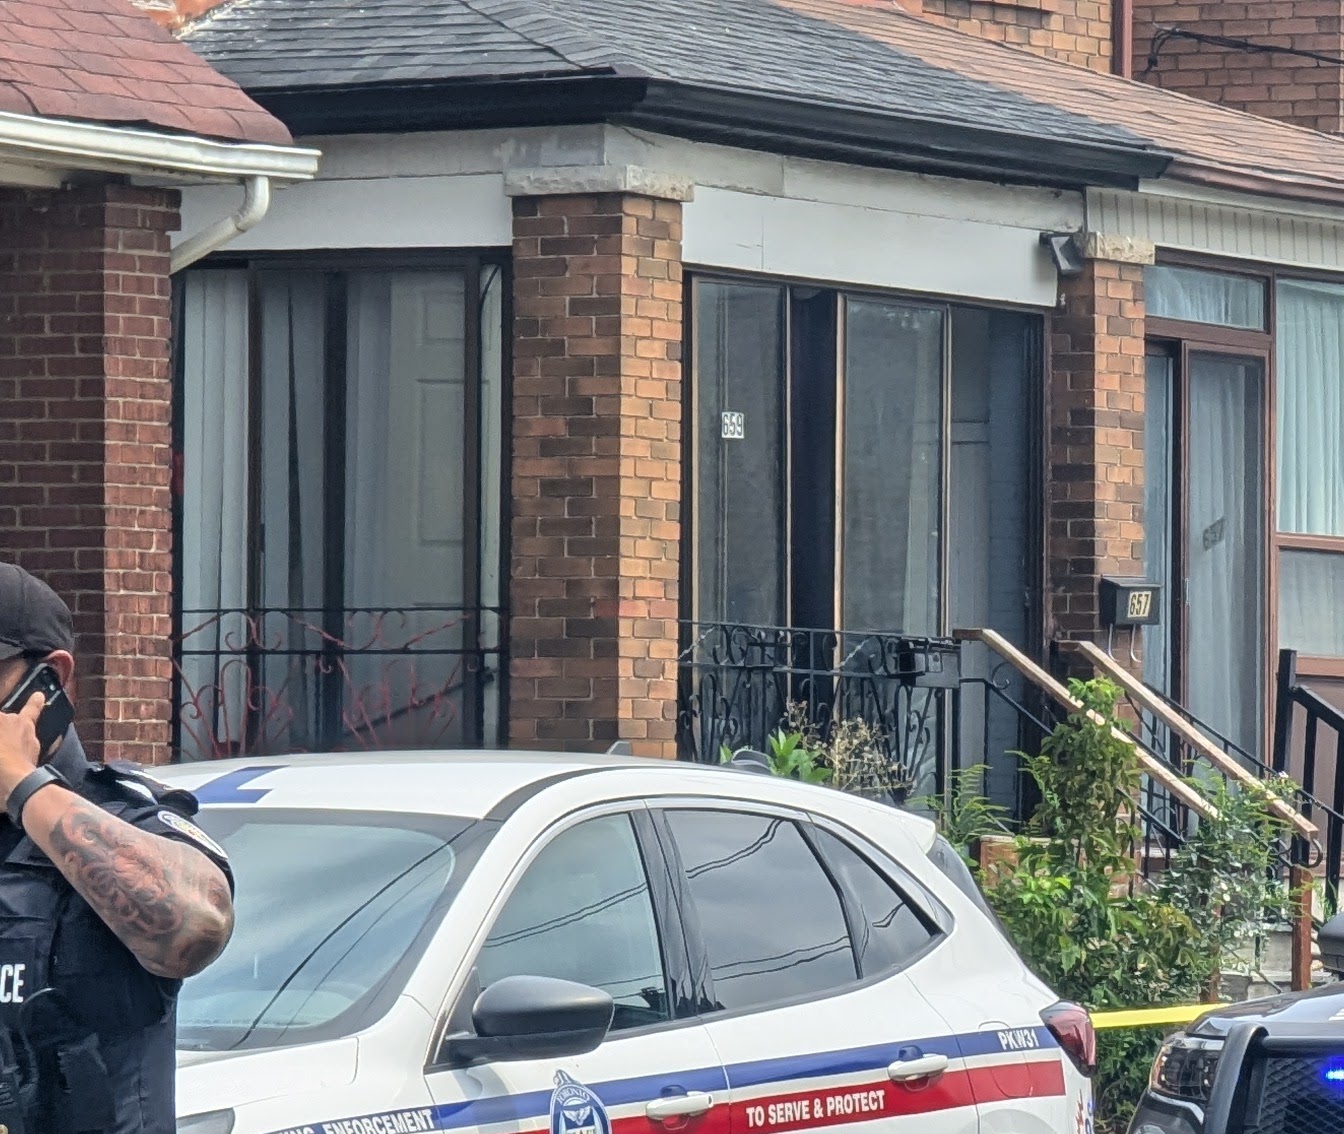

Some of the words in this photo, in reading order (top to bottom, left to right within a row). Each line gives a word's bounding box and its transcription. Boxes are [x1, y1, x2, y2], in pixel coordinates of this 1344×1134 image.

[722, 413, 743, 436] 659
[1129, 593, 1150, 616] 657
[997, 1028, 1040, 1051] PKW31
[556, 1088, 591, 1105] TORONTO
[745, 1105, 765, 1128] TO
[767, 1099, 811, 1125] SERVE
[813, 1097, 824, 1119] &
[826, 1089, 886, 1118] PROTECT
